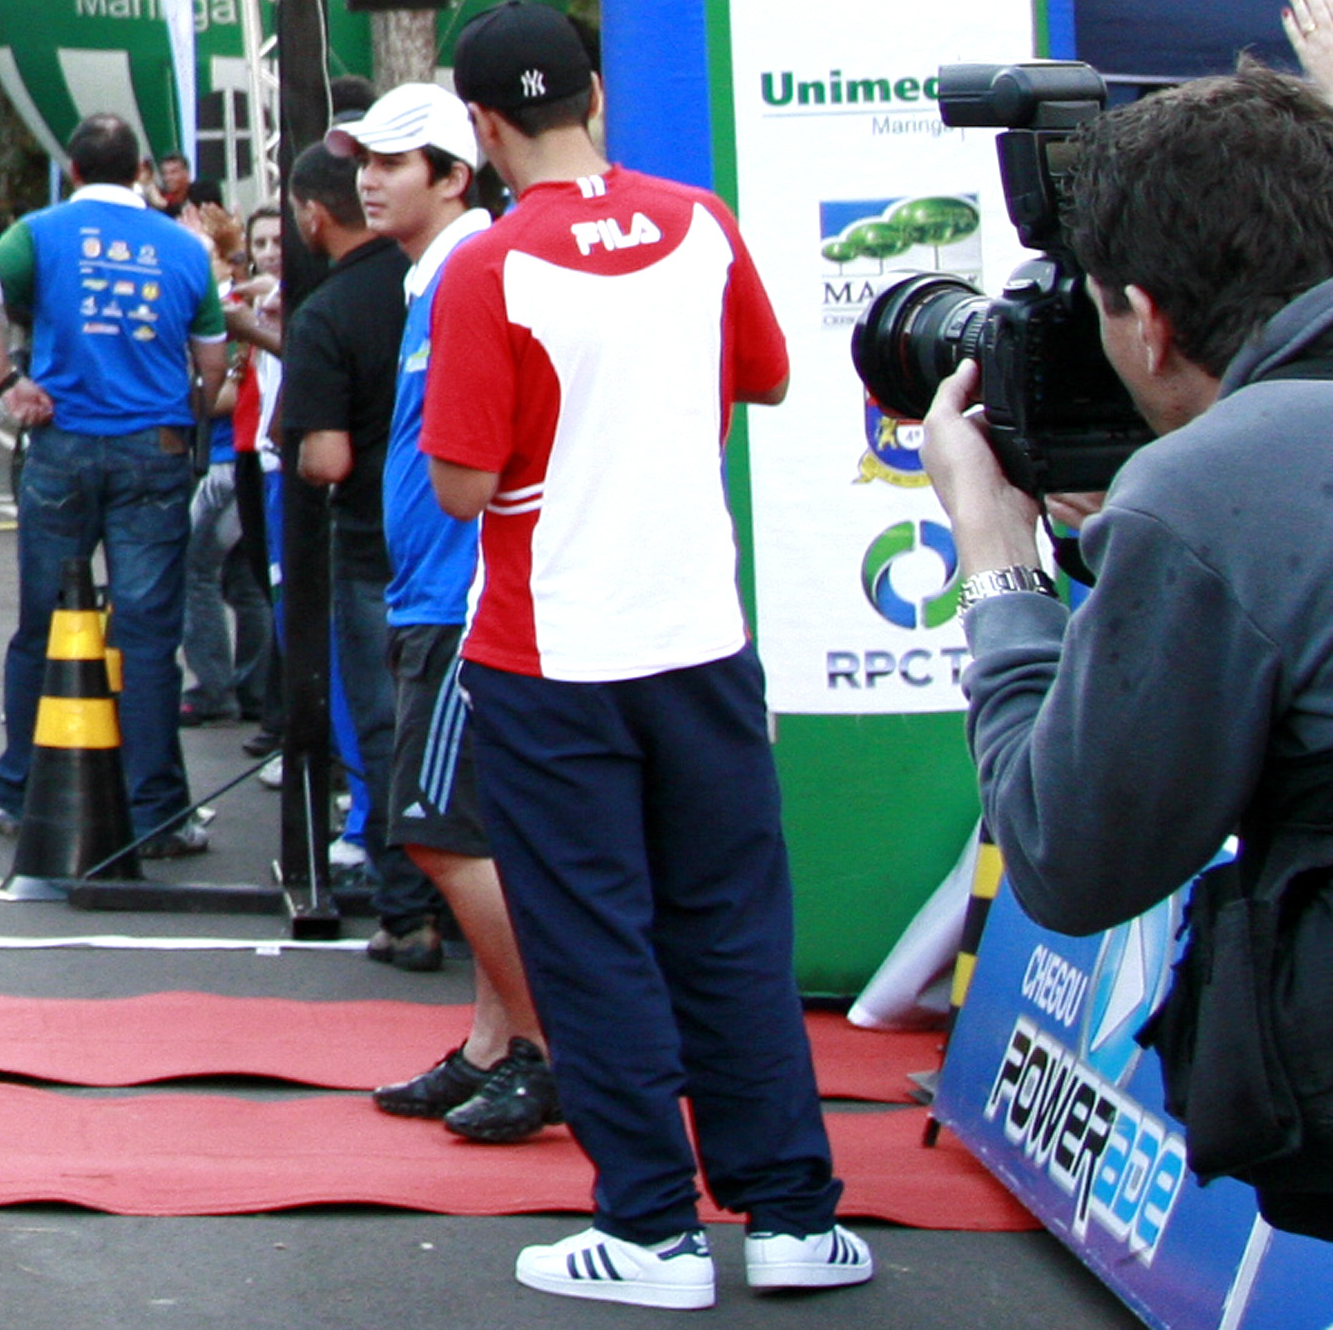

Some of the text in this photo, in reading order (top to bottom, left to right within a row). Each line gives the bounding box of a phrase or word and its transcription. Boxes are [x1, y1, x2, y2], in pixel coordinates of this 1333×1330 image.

[571, 212, 663, 256] FILA
[1020, 943, 1089, 1028] CHEGOU
[984, 1012, 1188, 1270] POWERADE
